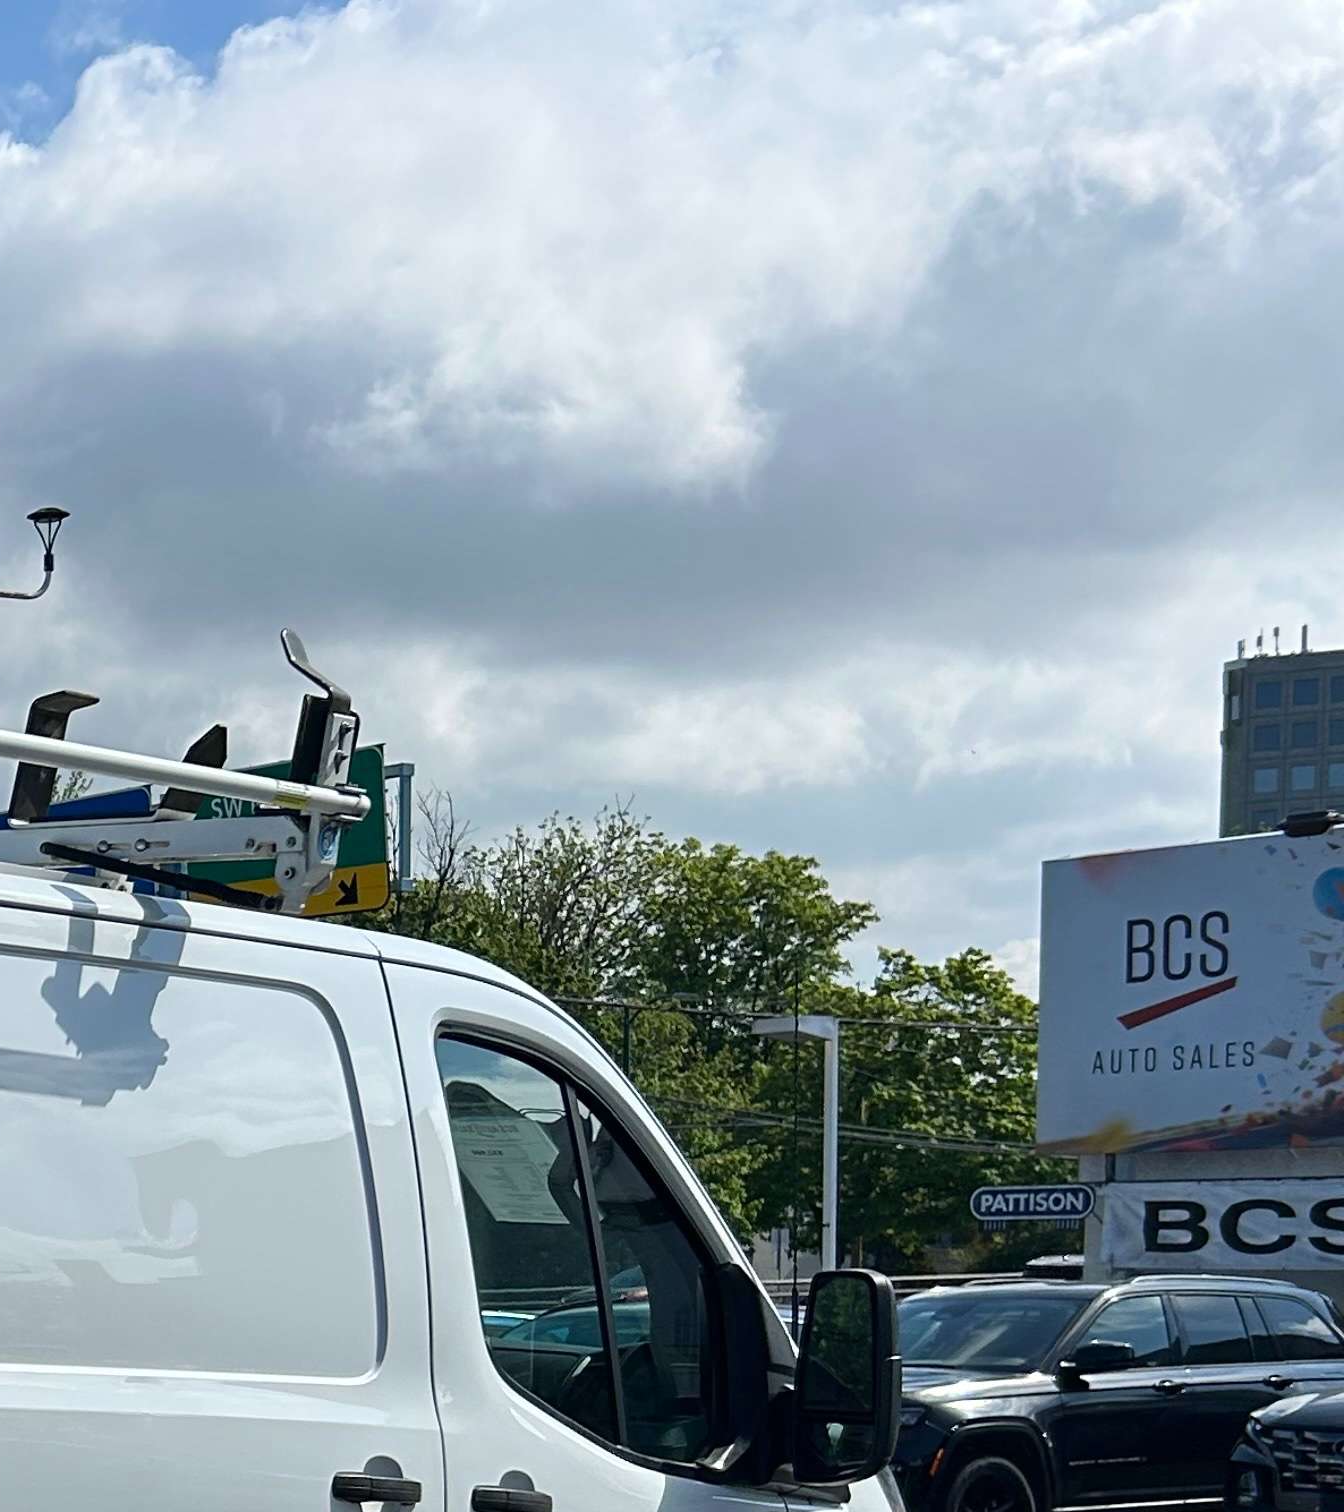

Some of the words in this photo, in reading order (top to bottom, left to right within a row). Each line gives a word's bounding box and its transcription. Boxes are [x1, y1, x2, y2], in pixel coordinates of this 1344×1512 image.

[211, 798, 243, 819] SW
[1125, 910, 1230, 984] BCS
[1092, 1047, 1157, 1075] AUTO
[1172, 1041, 1255, 1071] SALES
[979, 1192, 1084, 1213] PATTISON
